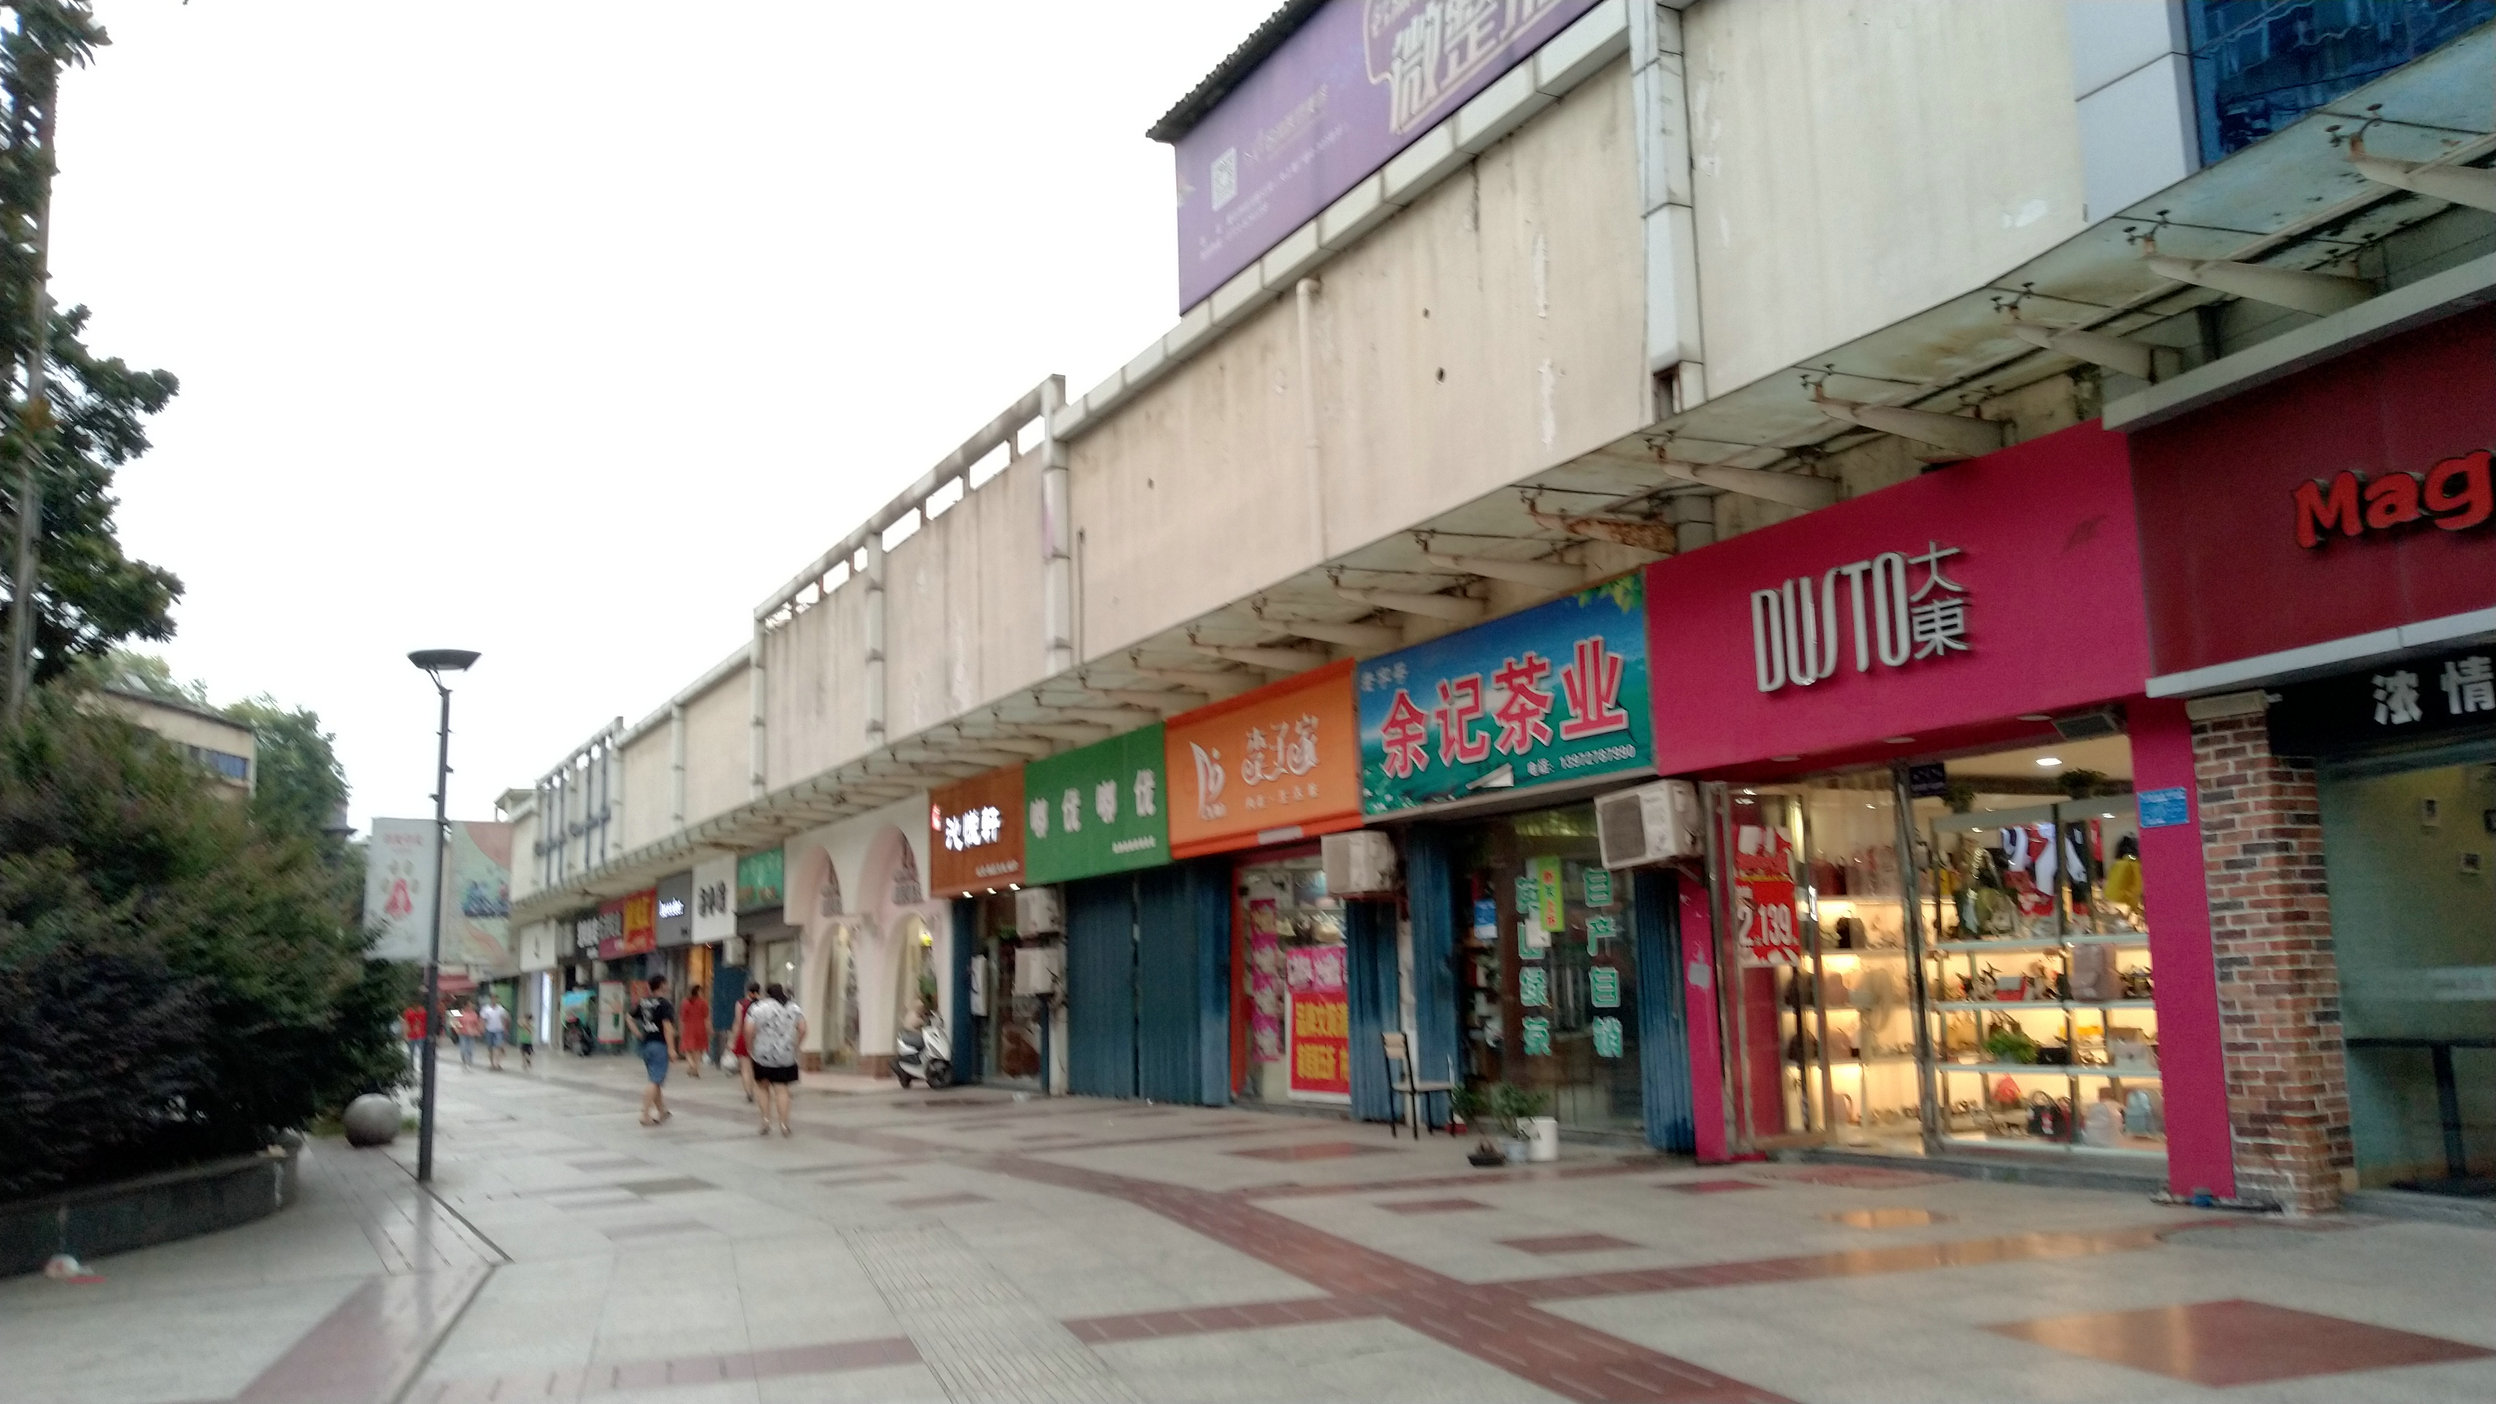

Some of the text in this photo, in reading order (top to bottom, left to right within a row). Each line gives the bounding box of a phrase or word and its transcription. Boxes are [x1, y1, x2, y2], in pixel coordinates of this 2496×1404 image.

[2292, 449, 2494, 549] Mag
[1751, 551, 1912, 694] DUSTO
[1909, 541, 1970, 660] 大東
[1380, 635, 1631, 779] 余记茶业
[2371, 656, 2496, 726] 浓情
